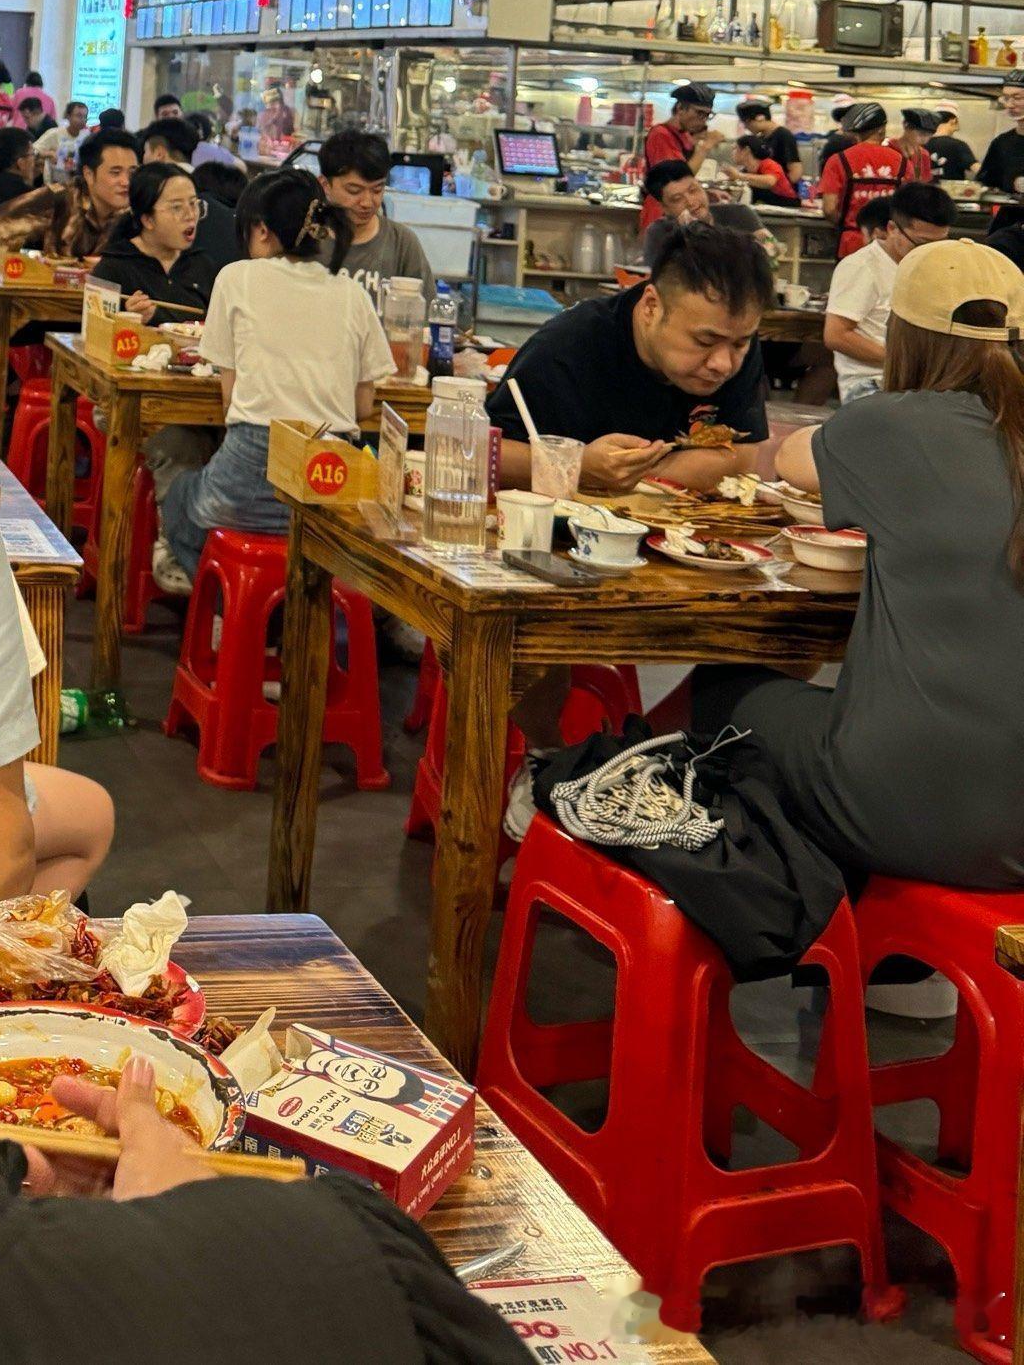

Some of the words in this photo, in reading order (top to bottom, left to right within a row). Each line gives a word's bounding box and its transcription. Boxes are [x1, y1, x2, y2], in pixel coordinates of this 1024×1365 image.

[117, 336, 138, 351] A15
[310, 463, 344, 484] A16
[316, 1089, 337, 1104] Nan
[326, 1094, 351, 1113] From
[291, 1105, 320, 1126] Chang
